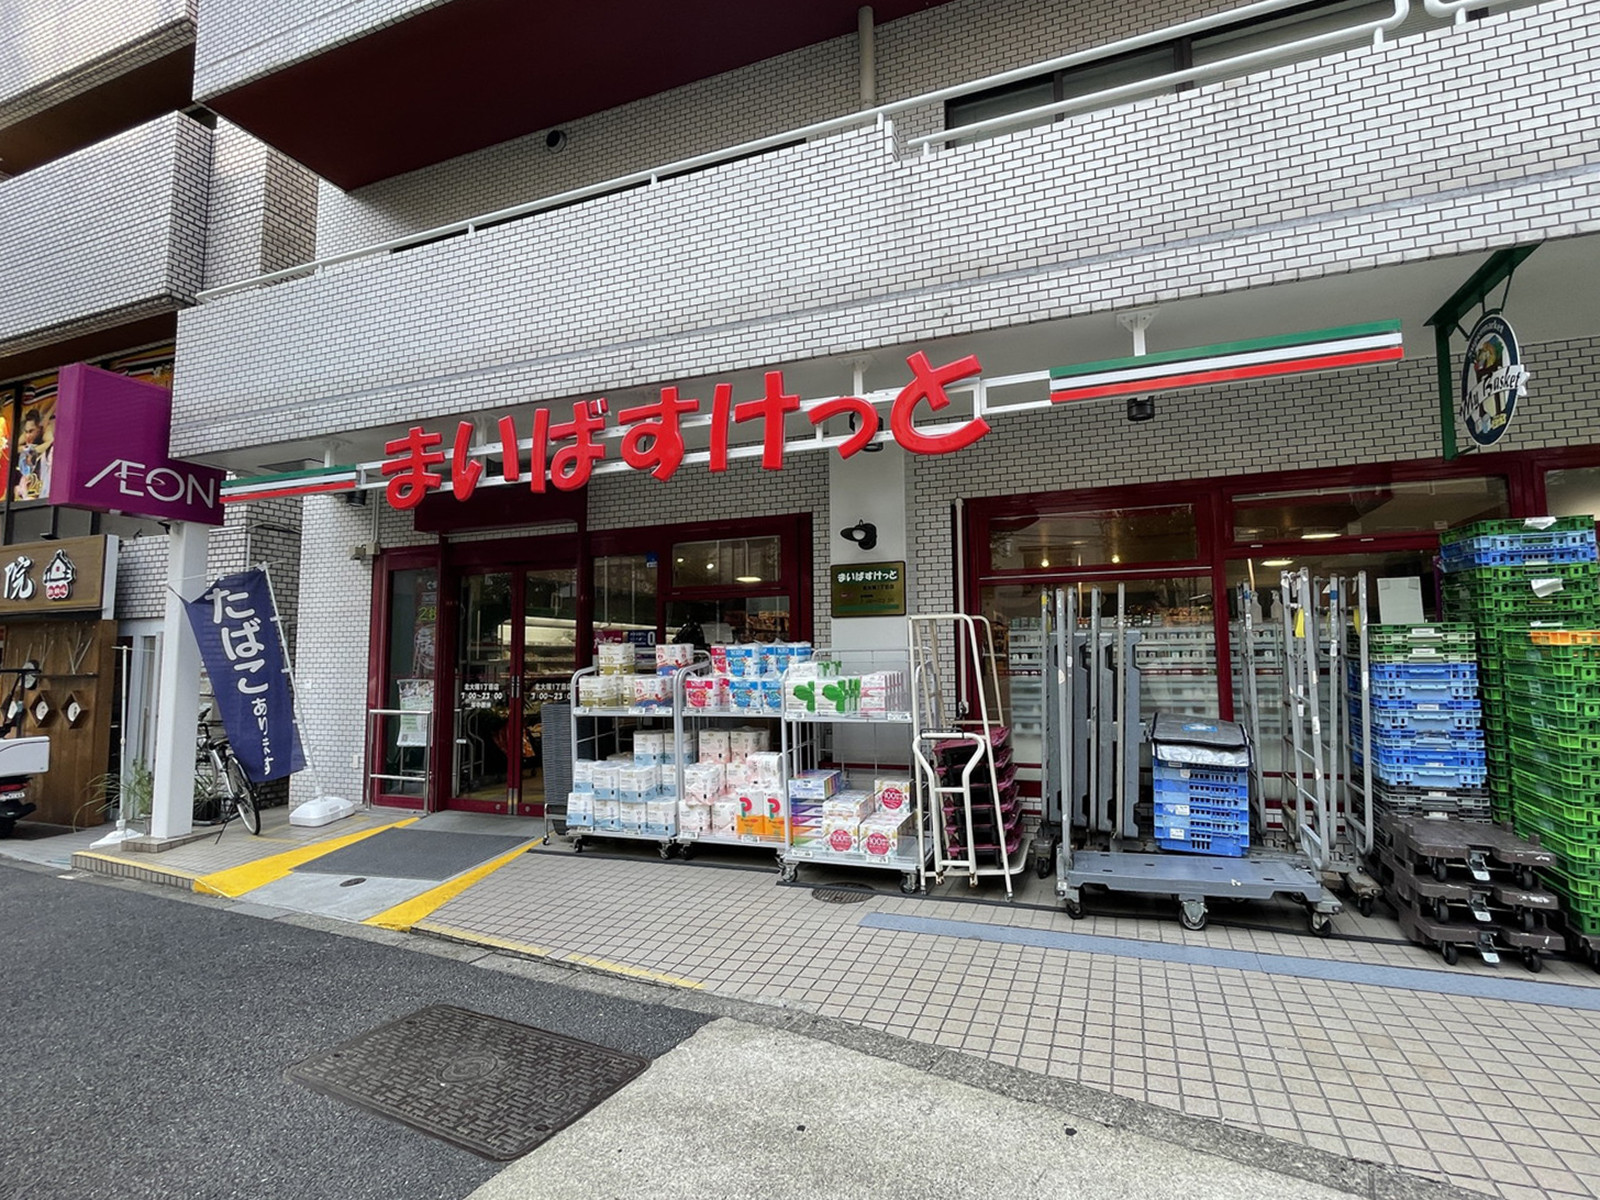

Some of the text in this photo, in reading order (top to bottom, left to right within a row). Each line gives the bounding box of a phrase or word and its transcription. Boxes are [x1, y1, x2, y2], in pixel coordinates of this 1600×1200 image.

[1483, 367, 1520, 396] Basket
[381, 351, 991, 510] まいばすけっと
[4, 556, 35, 600] 院
[837, 570, 898, 583] まいばすけっと
